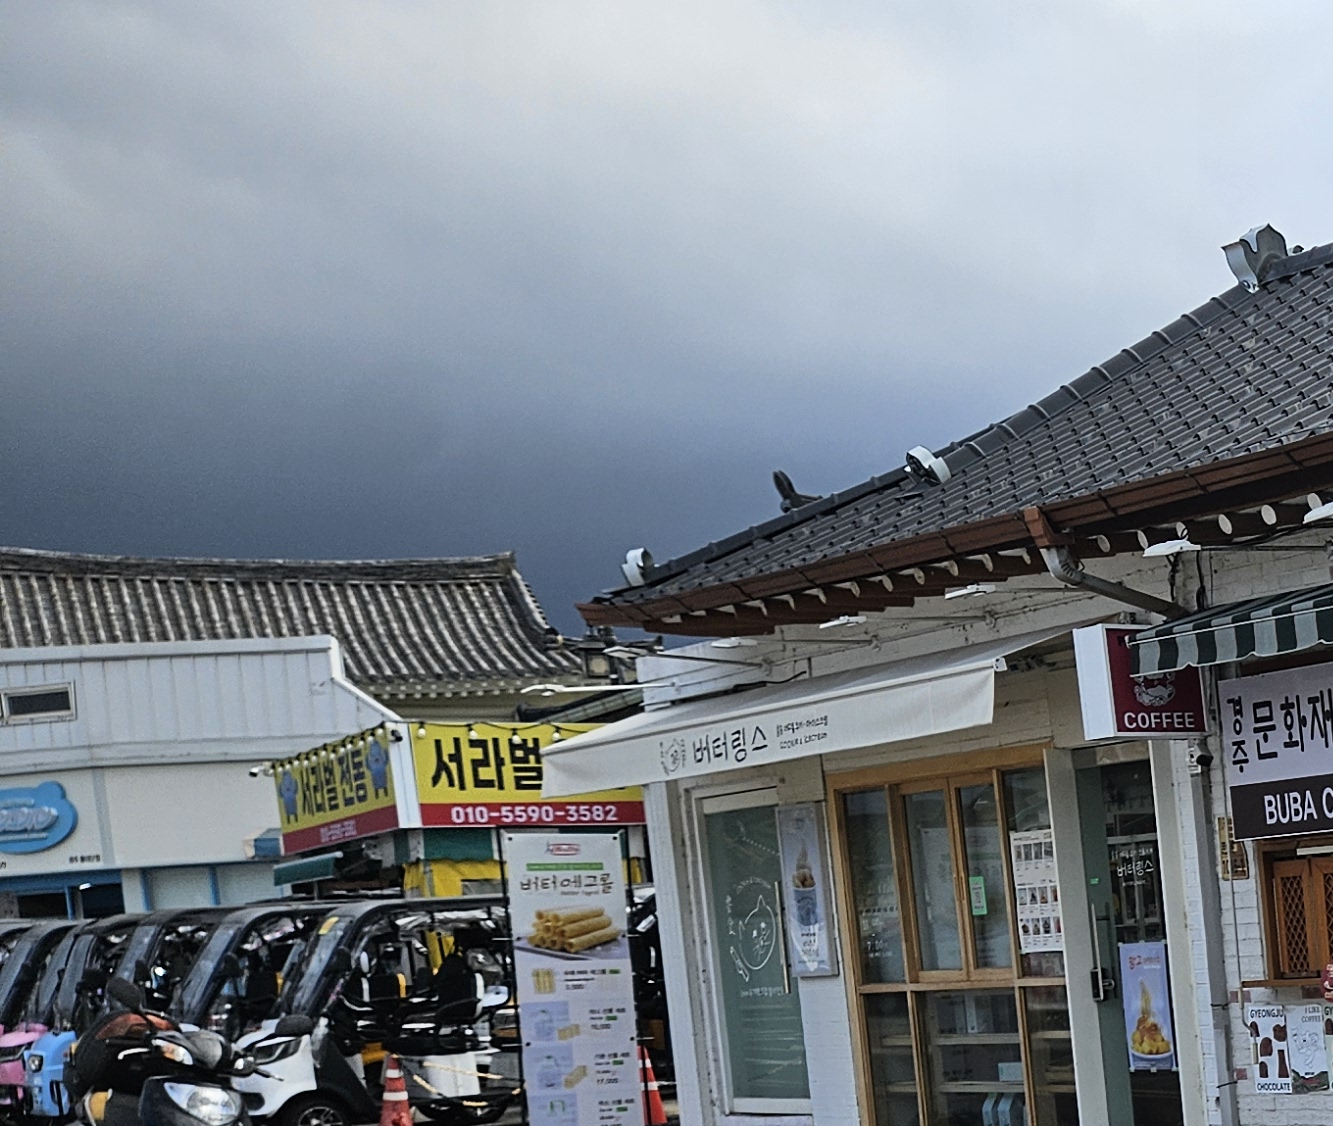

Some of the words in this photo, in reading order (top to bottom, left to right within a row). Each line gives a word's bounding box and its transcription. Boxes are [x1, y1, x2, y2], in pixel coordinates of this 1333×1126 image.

[1124, 711, 1195, 730] COFFEE
[1227, 695, 1250, 773] 경주
[692, 726, 768, 764] 버터링스
[432, 737, 542, 791] 서라벌
[301, 761, 340, 815] 서라벌
[338, 749, 368, 807] 전동
[450, 804, 618, 824] 010-5590-3582
[1264, 789, 1318, 825] BUBA
[520, 873, 614, 894] 버터에그롤
[1250, 1008, 1285, 1019] GYEONGJU
[1256, 1082, 1291, 1092] CHOCOLATE
